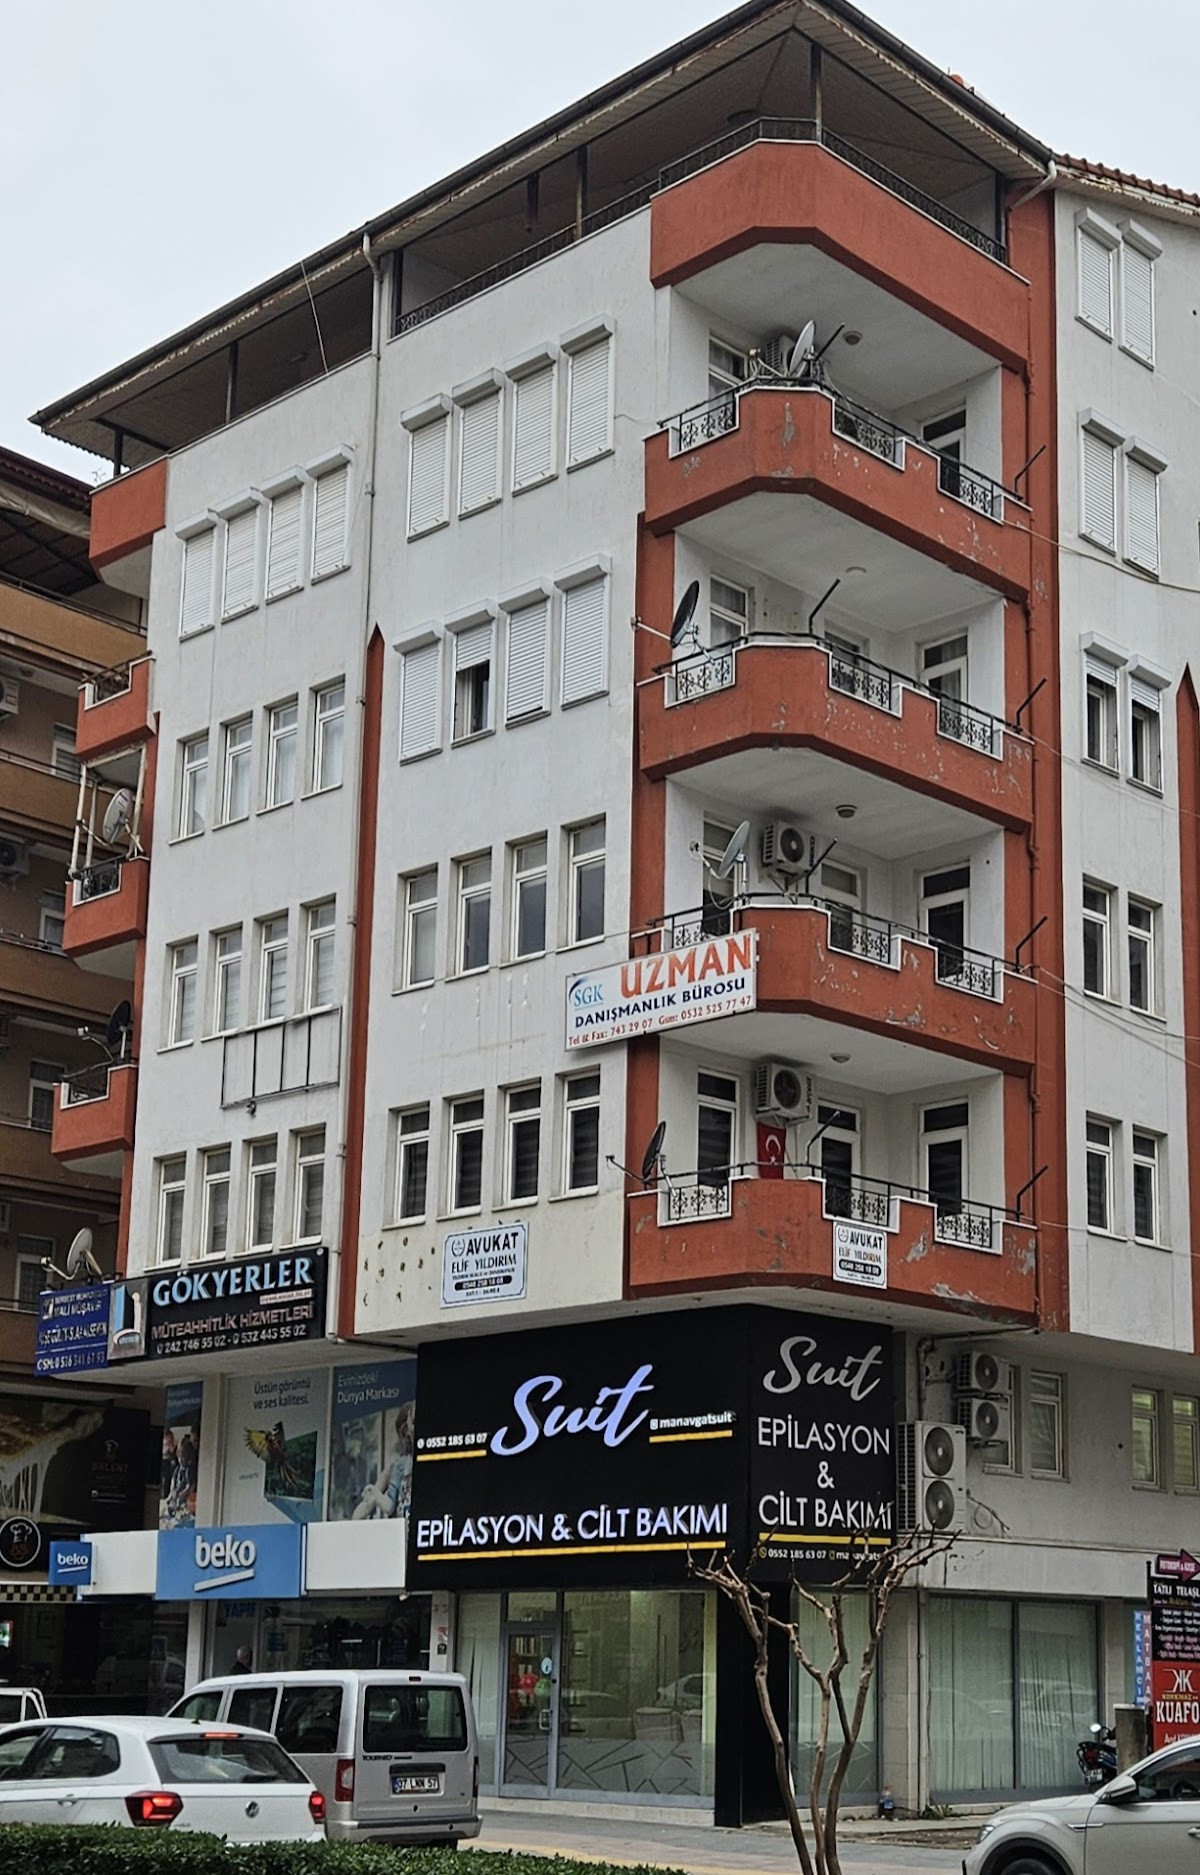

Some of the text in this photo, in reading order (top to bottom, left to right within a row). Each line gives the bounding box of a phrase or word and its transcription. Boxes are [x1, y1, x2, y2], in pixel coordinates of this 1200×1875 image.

[620, 934, 751, 999] UZMAN
[574, 983, 604, 1006] SGK
[575, 977, 745, 1028] DANIŞMANLIK BÜROSU
[568, 1035, 580, 1046] Tel
[591, 1030, 608, 1041] Fax:
[610, 1025, 626, 1036] 743
[629, 1021, 639, 1031] 29
[642, 1018, 653, 1029] 07
[658, 1015, 678, 1026] Gsm:
[681, 1007, 703, 1021] 0532
[706, 1002, 722, 1014] 525
[725, 998, 737, 1010] 77
[740, 996, 752, 1007] 47
[466, 1232, 519, 1256] AVUKAT
[850, 1231, 883, 1250] AVUKAT
[475, 1254, 517, 1270] YILDIRIM
[153, 1257, 315, 1307] GÖKYERLER
[152, 1301, 314, 1340] MÜTEAHHİTLİK HİZMETLERİ
[157, 1344, 163, 1354] 0
[164, 1340, 181, 1353] 242
[183, 1338, 199, 1350] 746
[201, 1337, 213, 1348] 55
[214, 1335, 226, 1347] 02
[233, 1333, 239, 1344] 0
[241, 1330, 258, 1343] 532
[279, 1326, 291, 1338] 55
[293, 1324, 306, 1336] 02
[761, 1335, 883, 1401] Suit
[254, 1378, 311, 1395] Üstün görüntü
[337, 1386, 399, 1406] Dünya Markası
[253, 1400, 263, 1410] ve
[264, 1397, 278, 1408] ses
[490, 1364, 654, 1457] Suit
[659, 1411, 733, 1428] manavgatsuit
[426, 1432, 488, 1448] 0552 185 63 07
[757, 1414, 890, 1456] EPİLASYON
[817, 1461, 835, 1489] &
[759, 1490, 892, 1530] CİLT BAKIMI
[417, 1503, 727, 1548] EPİLASYON & CİLT BAKIMI
[57, 1553, 89, 1565] beko
[194, 1534, 256, 1568] beko
[768, 1548, 788, 1558] 0552
[790, 1549, 804, 1559] 185
[805, 1549, 815, 1559] 63
[816, 1550, 826, 1559] 07
[1153, 1584, 1172, 1595] TATLI
[1142, 1614, 1152, 1695] MATBAA
[398, 1777, 407, 1789] 07
[427, 1777, 438, 1788] 57
